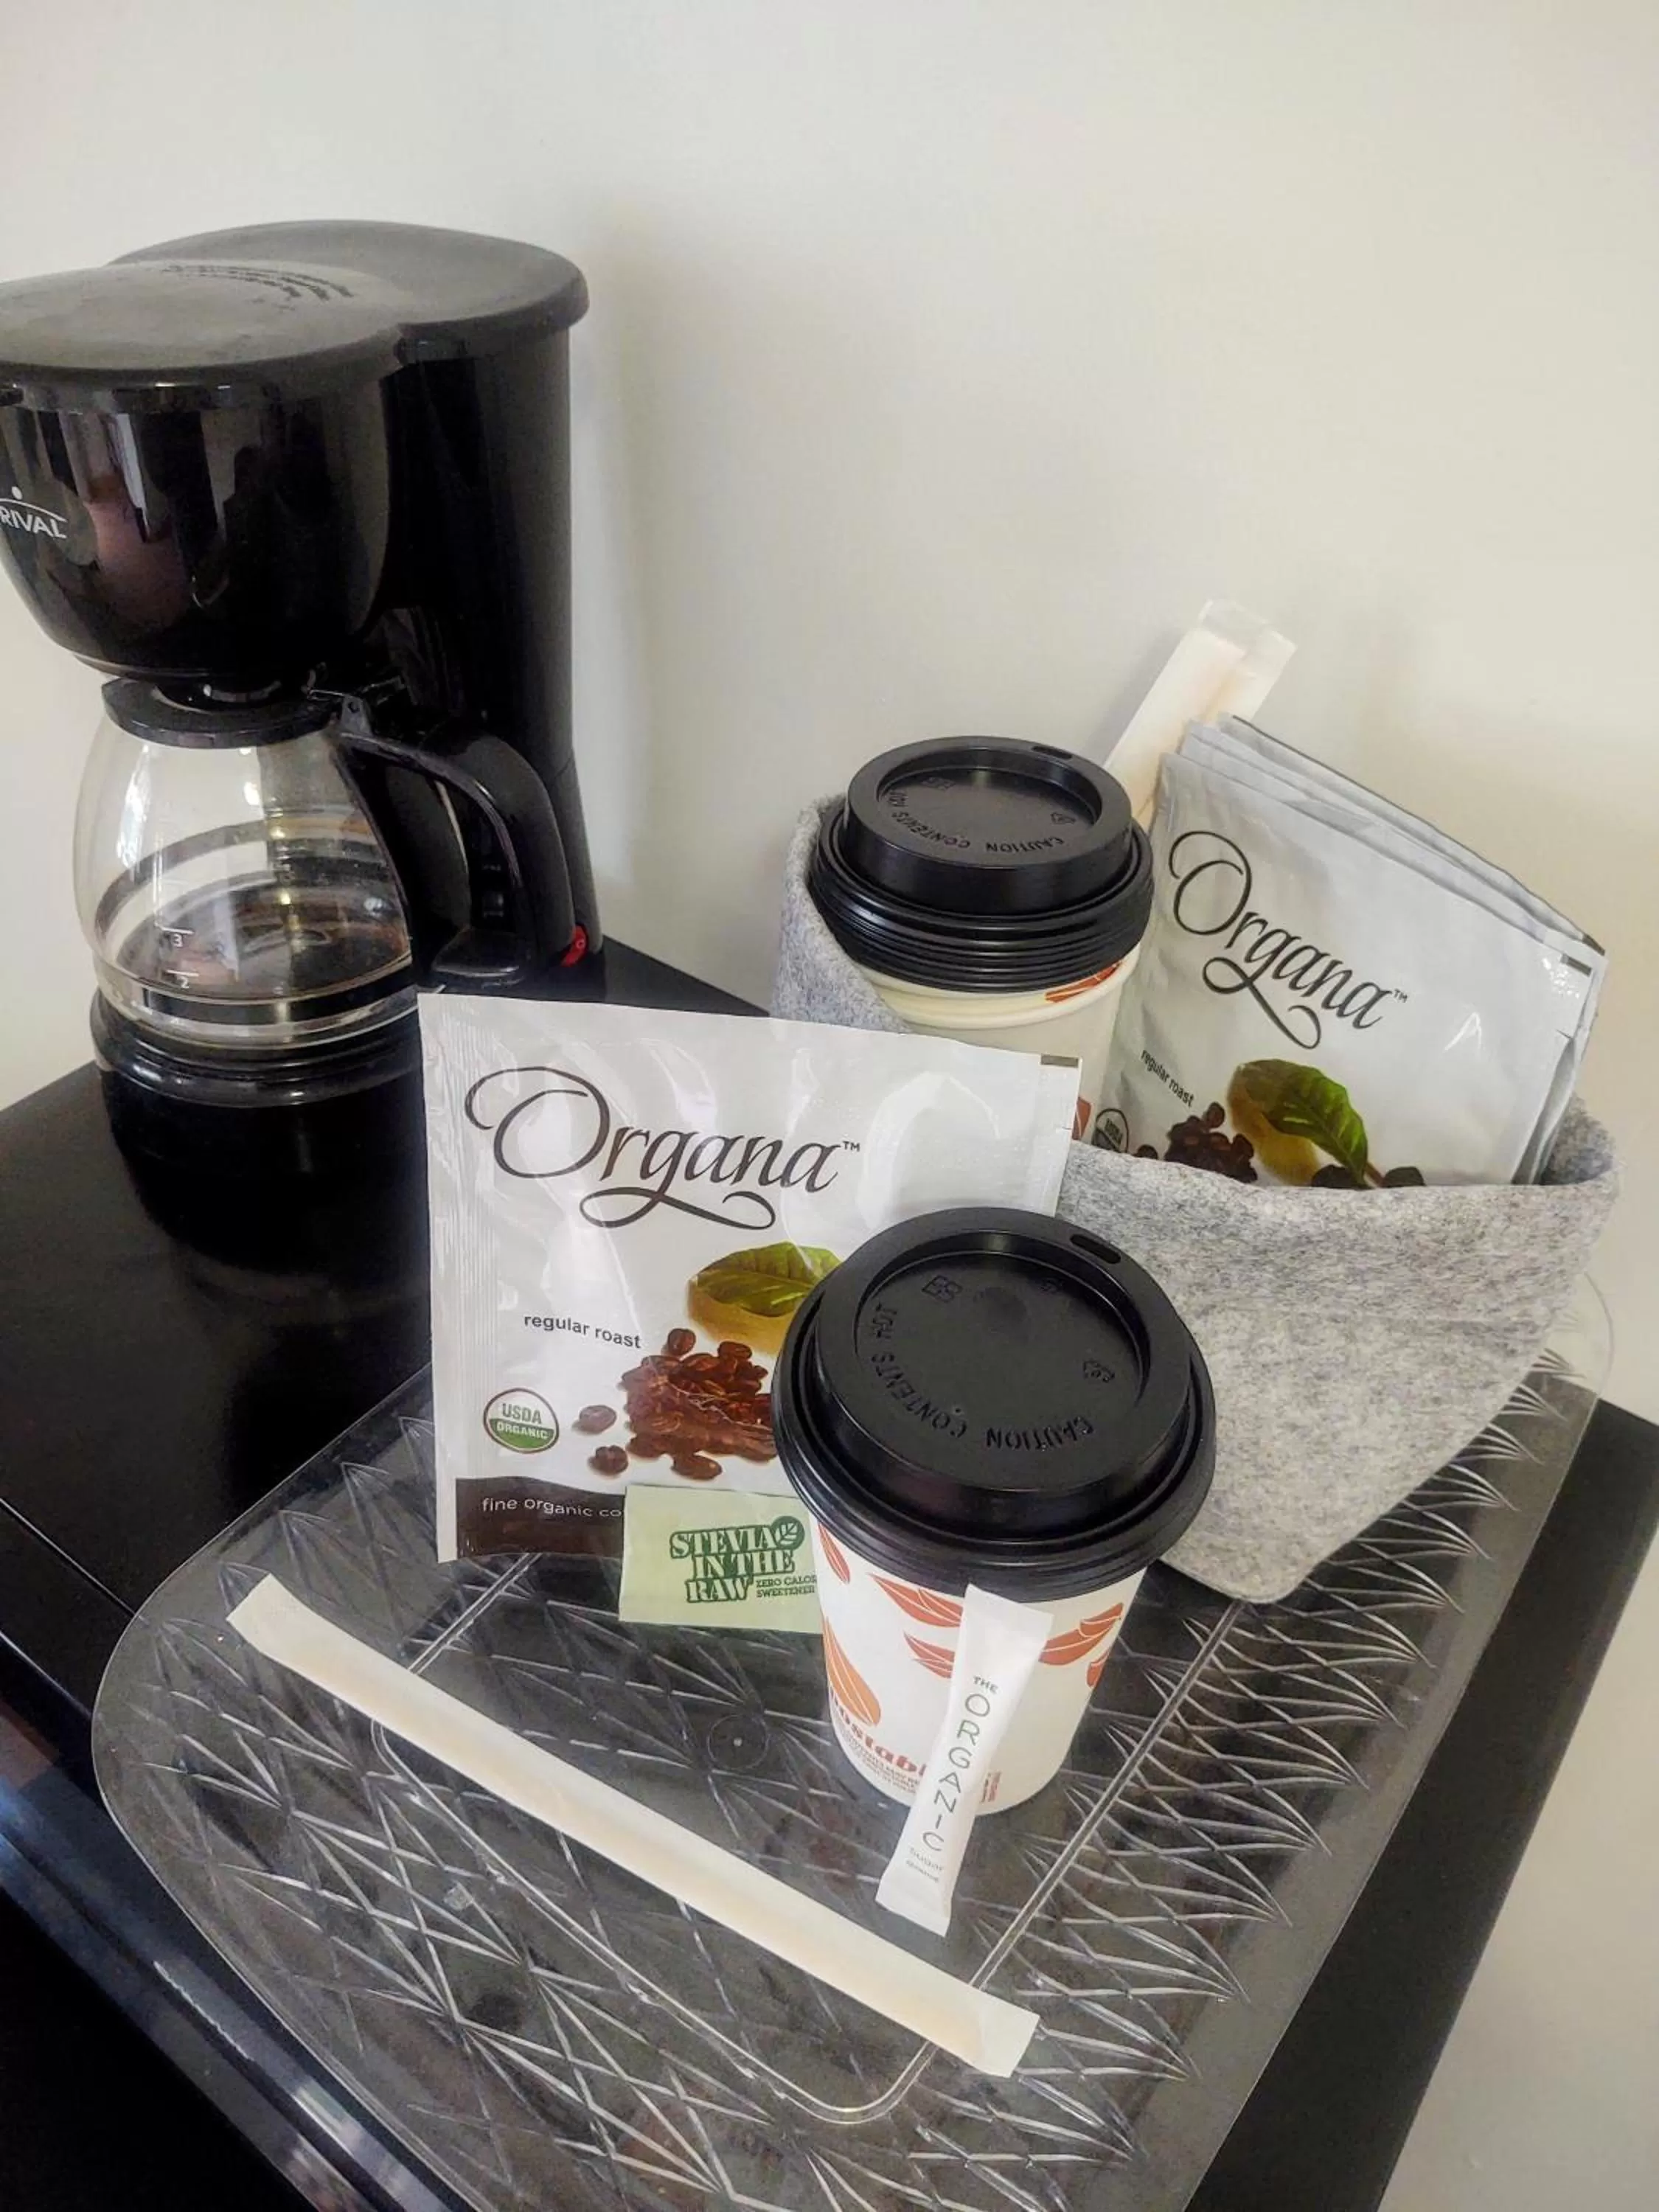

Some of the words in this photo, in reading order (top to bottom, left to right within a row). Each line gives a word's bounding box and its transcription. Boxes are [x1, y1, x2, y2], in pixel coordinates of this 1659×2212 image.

[0, 505, 67, 538] RIVAL
[171, 933, 184, 947] 3
[1169, 831, 1392, 1049] Organa
[1141, 1050, 1169, 1082] regular
[1169, 1079, 1194, 1107] roast
[465, 1066, 841, 1230] Organa
[524, 1315, 590, 1335] regular
[595, 1328, 641, 1349] roast
[501, 1402, 543, 1425] USDA
[496, 1421, 549, 1440] ORGANIC
[481, 1498, 518, 1512] fine
[670, 1525, 776, 1558] STEVIA
[694, 1554, 727, 1579] IN
[731, 1548, 795, 1576] THE
[685, 1577, 751, 1603] RAW
[973, 1675, 998, 1694] THE
[922, 1693, 991, 1852] ORGANIC
